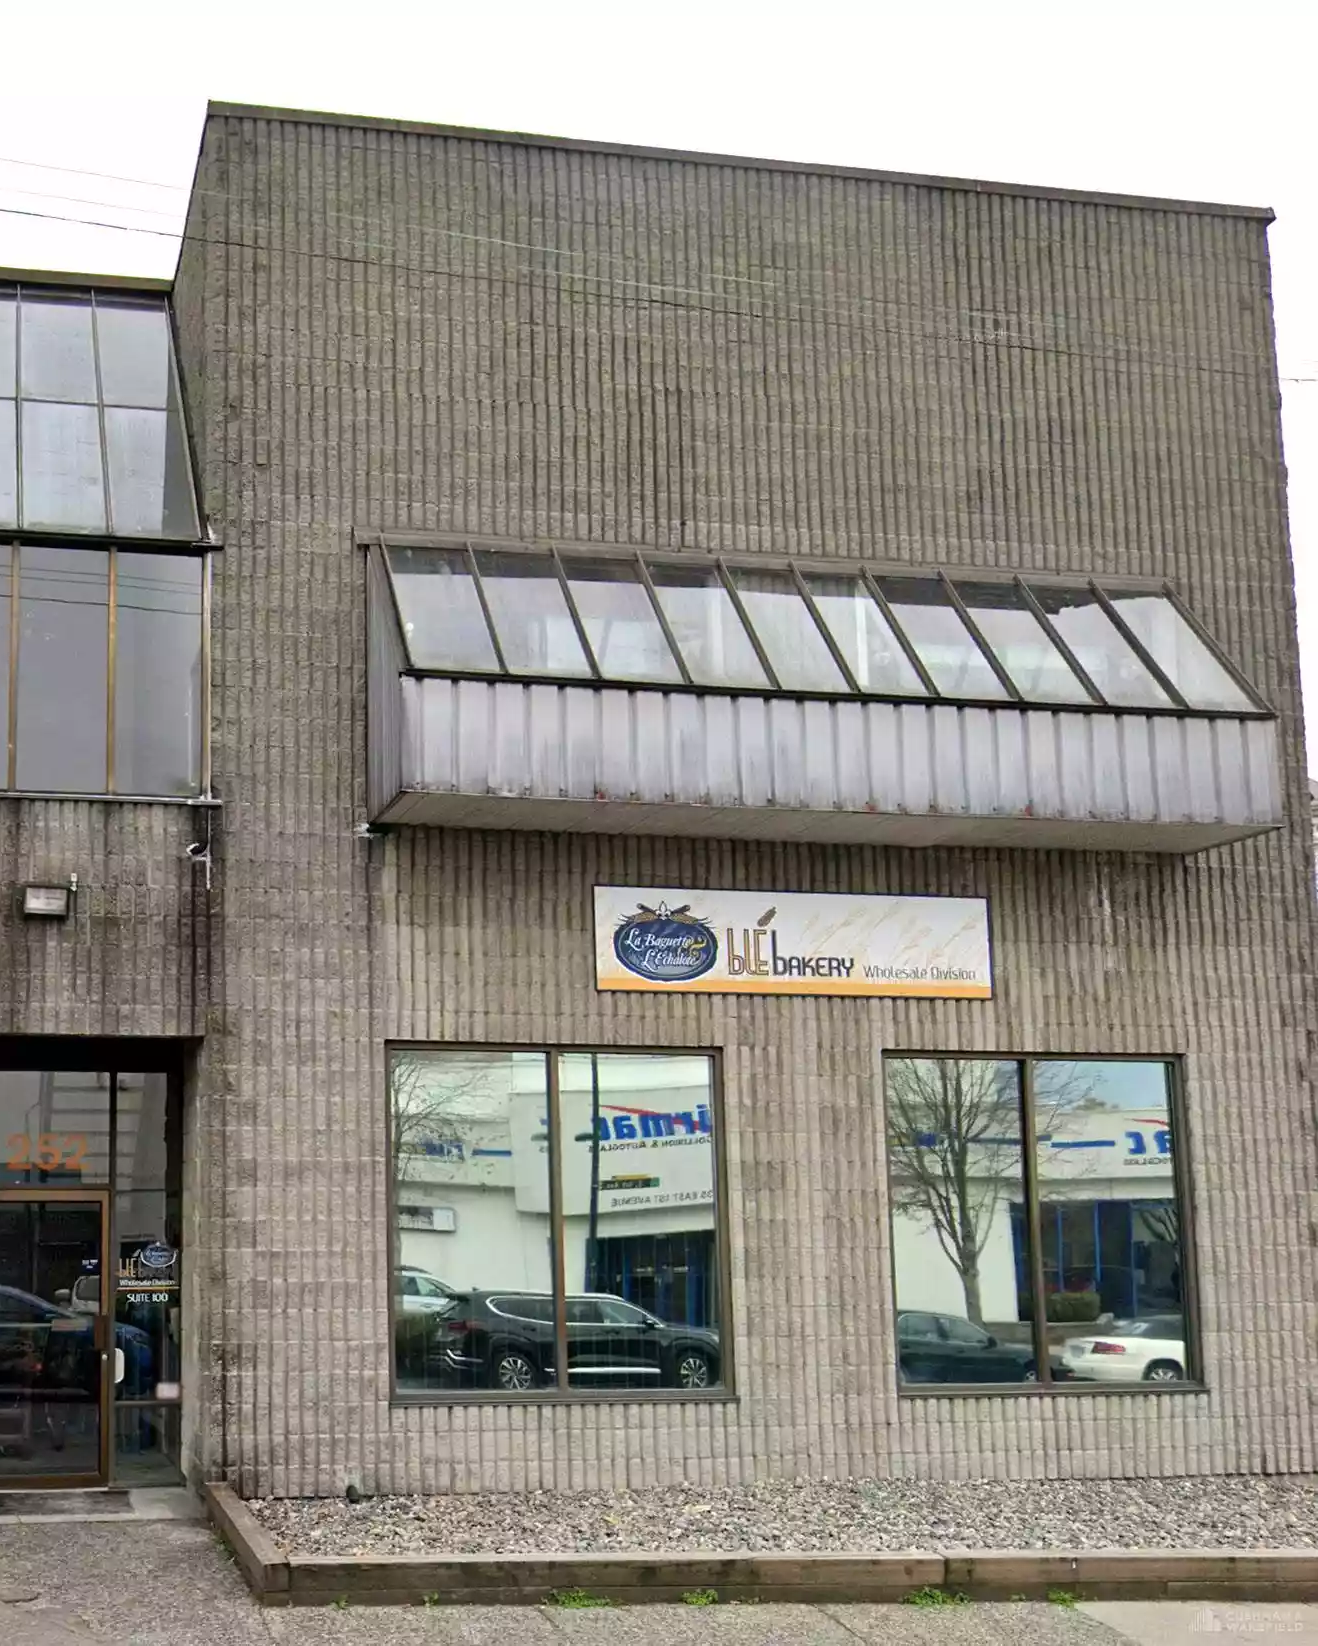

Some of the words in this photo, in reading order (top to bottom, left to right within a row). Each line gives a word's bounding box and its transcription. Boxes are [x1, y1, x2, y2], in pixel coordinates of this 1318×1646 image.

[624, 928, 644, 951] La
[644, 933, 695, 950] Baguette
[862, 965, 927, 979] Wholesale
[931, 966, 976, 980] Division
[6, 1132, 90, 1171] 252
[127, 1293, 150, 1302] SUITE
[152, 1293, 168, 1302] 100
